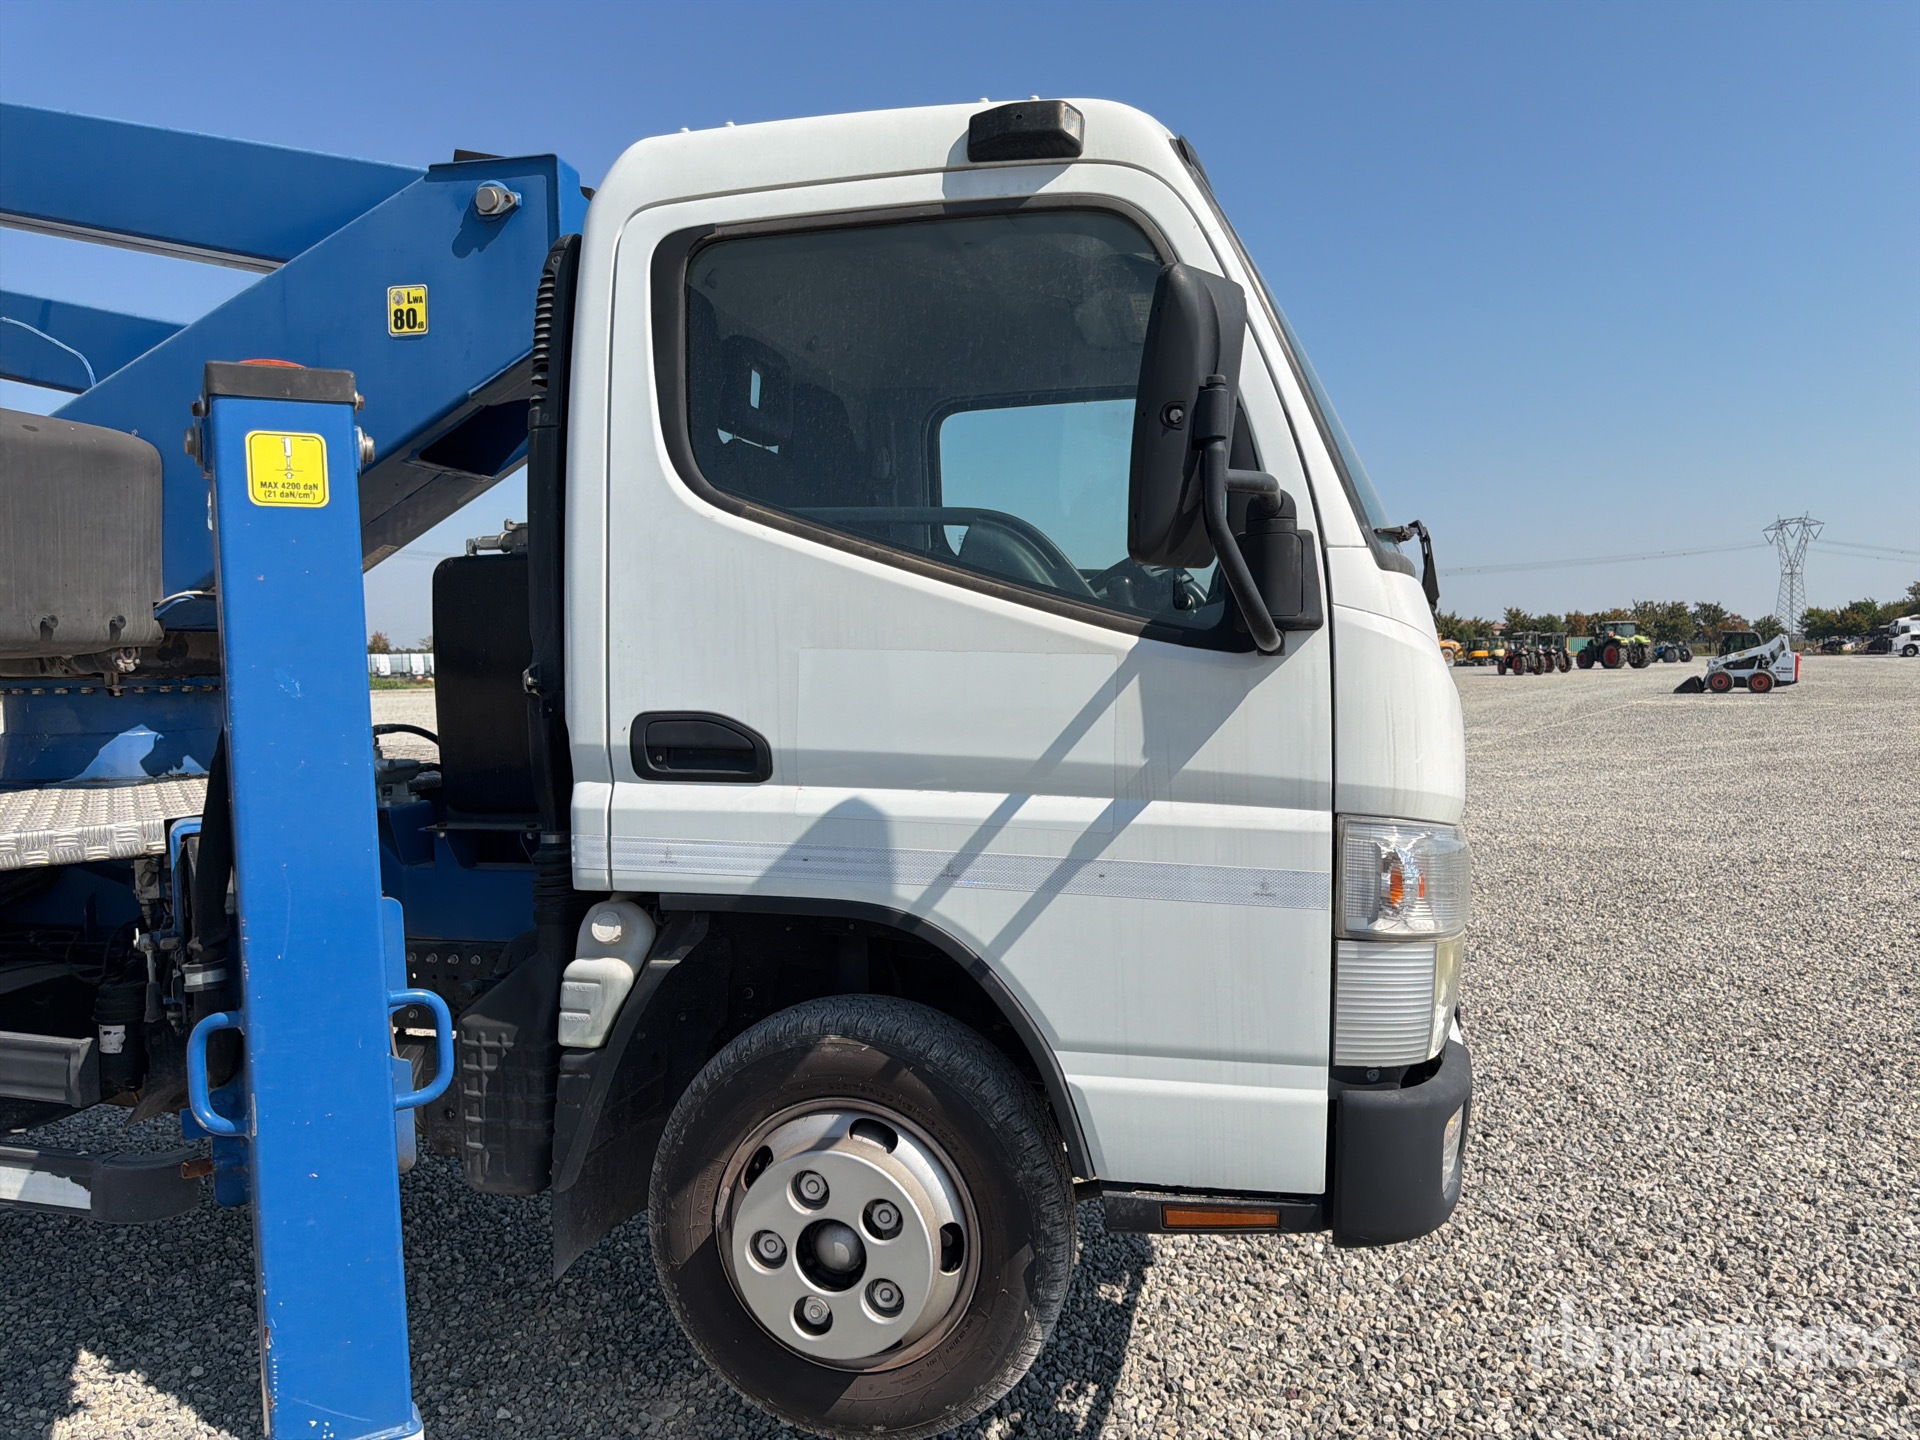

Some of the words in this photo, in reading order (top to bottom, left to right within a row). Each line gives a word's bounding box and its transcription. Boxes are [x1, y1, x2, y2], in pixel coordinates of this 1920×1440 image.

[393, 307, 417, 330] 80
[260, 481, 279, 489] MAX
[281, 482, 301, 490] 4200
[303, 482, 319, 491] daN
[264, 490, 277, 499] (21
